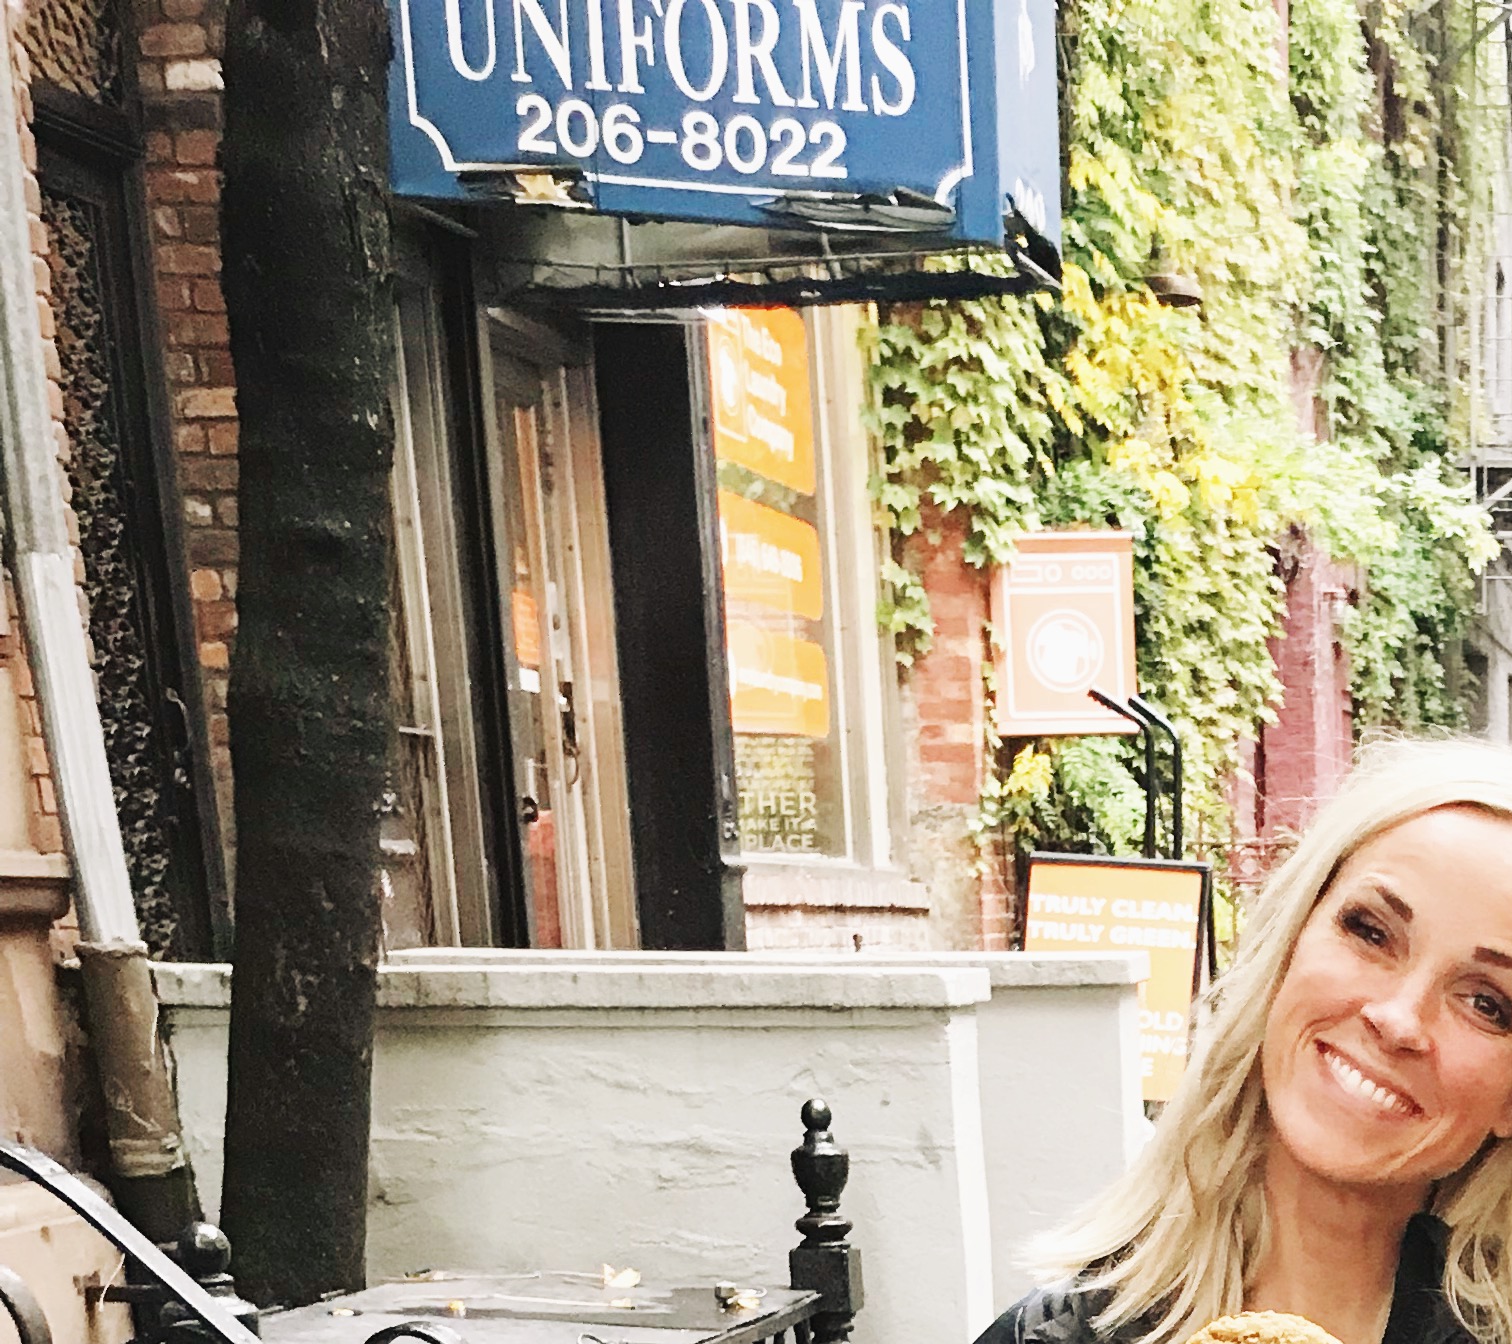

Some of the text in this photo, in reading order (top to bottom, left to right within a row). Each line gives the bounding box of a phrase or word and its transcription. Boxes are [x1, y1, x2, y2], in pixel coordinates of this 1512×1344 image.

[445, 0, 917, 117] UNIFORMS
[515, 94, 848, 178] 206-8022
[743, 833, 815, 851] PLACE
[1029, 893, 1200, 924] TRULY CLEAN.
[1027, 919, 1197, 950] TRULY GREEN.
[1137, 1009, 1184, 1031] OLD
